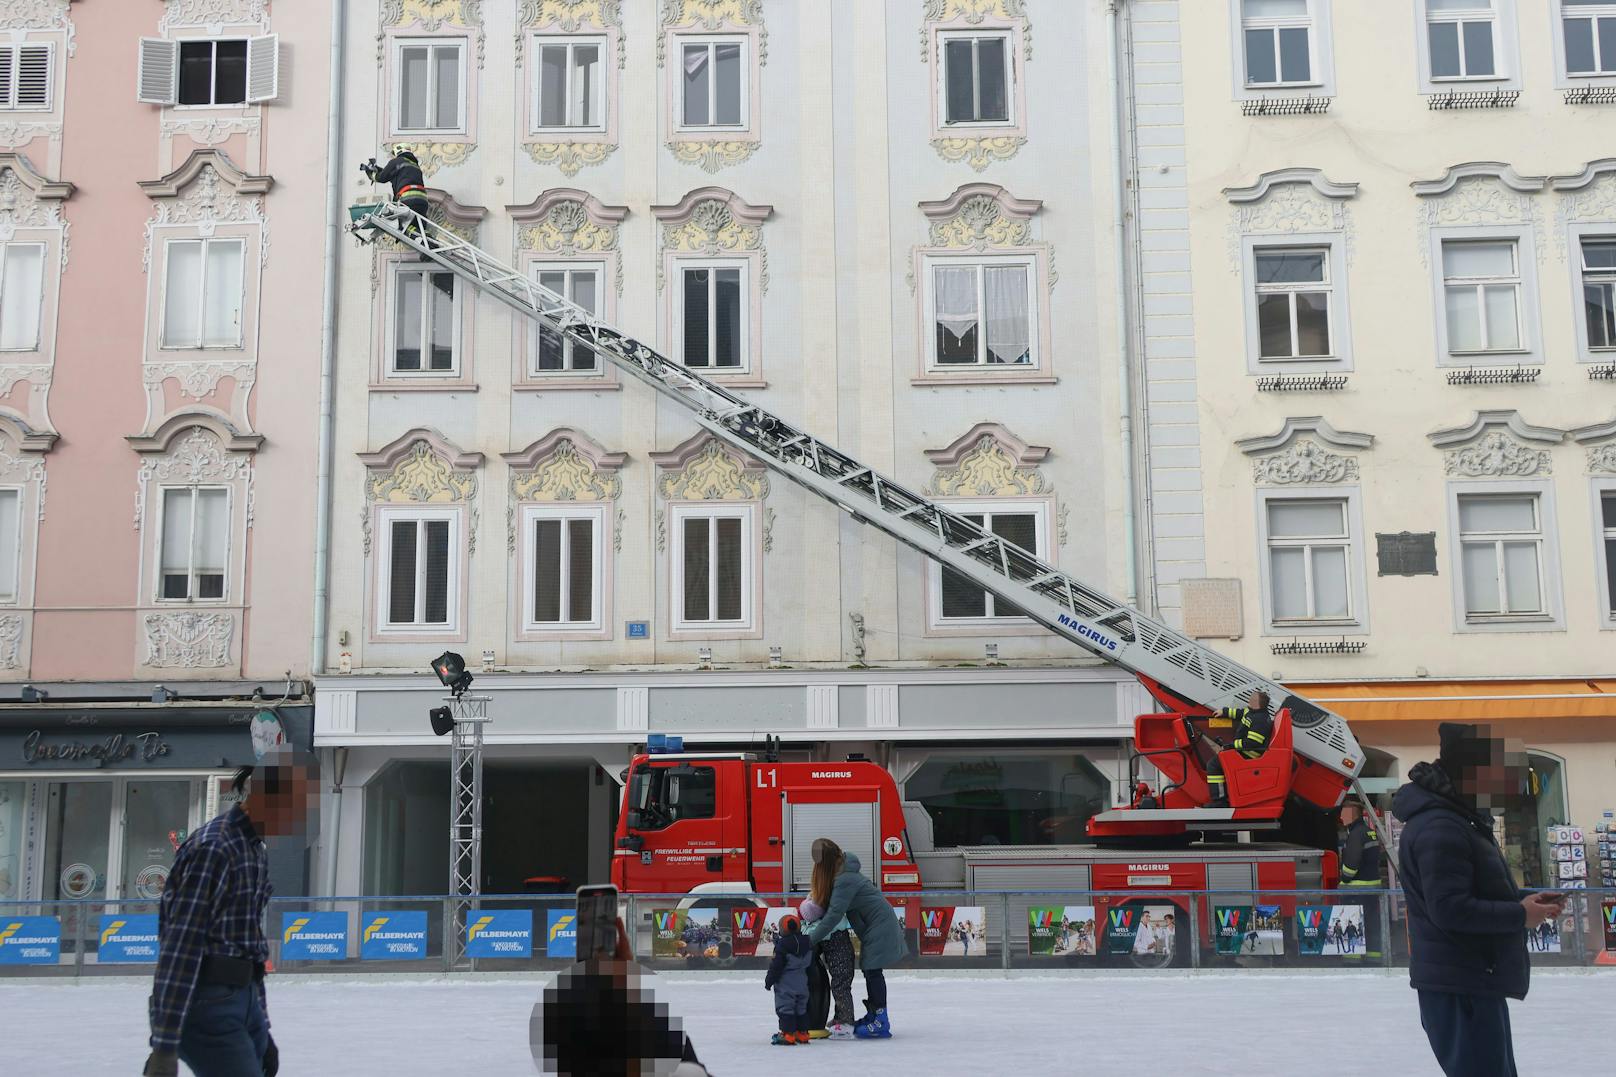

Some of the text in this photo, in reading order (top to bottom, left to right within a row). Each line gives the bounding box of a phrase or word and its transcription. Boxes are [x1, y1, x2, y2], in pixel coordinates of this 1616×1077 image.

[1057, 613, 1118, 651] MAGIRUS
[757, 768, 777, 788] L1
[811, 771, 852, 779] MAGIRUS
[291, 932, 344, 940] FELBERMAYR
[371, 932, 424, 940] FELBERMAYR
[557, 930, 577, 938] FELB
[4, 936, 58, 945] FELBERMAYR
